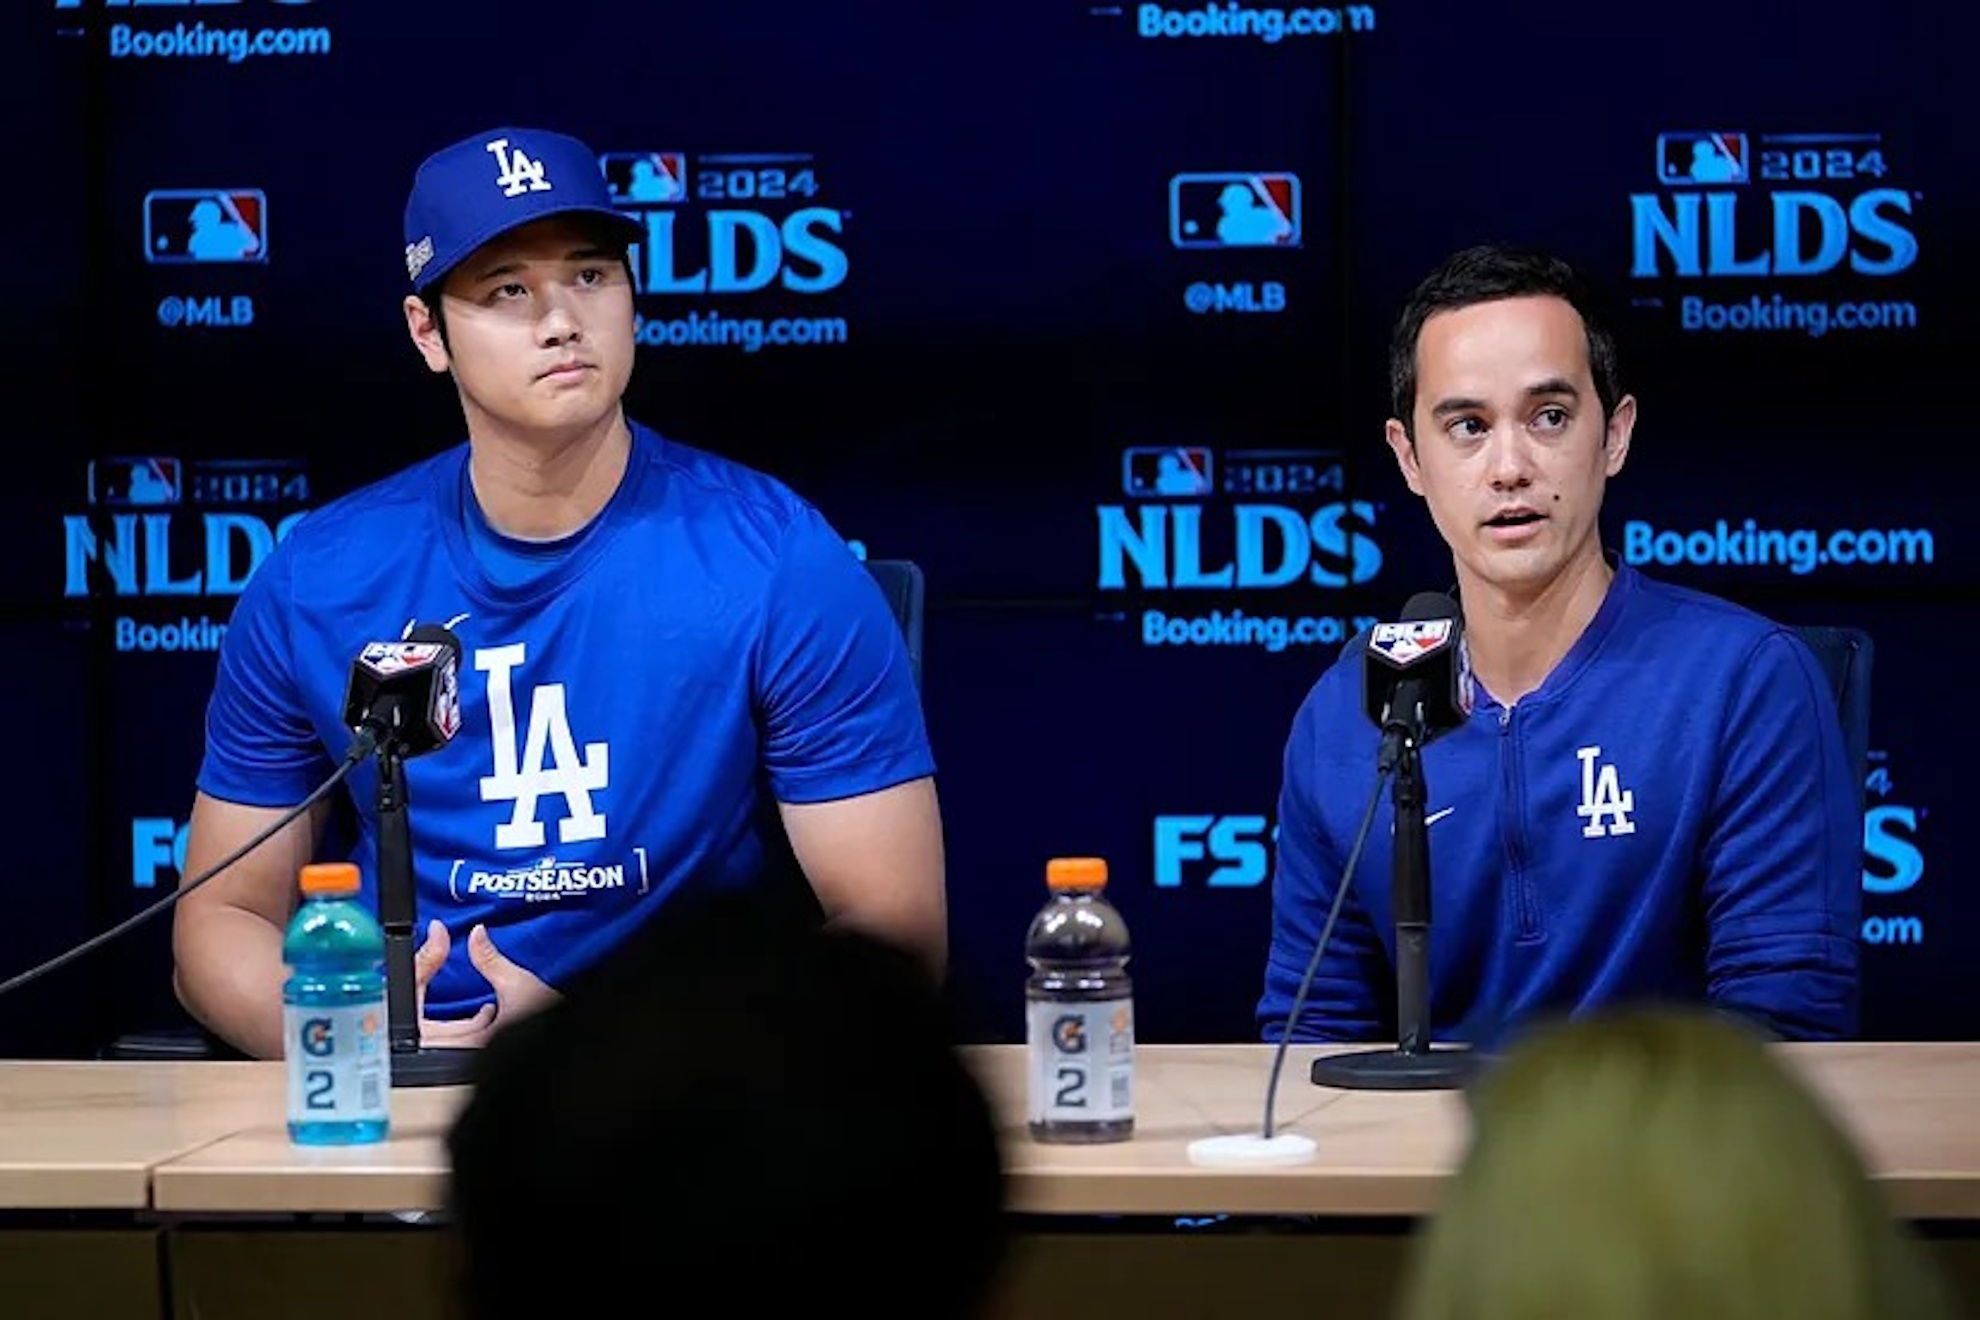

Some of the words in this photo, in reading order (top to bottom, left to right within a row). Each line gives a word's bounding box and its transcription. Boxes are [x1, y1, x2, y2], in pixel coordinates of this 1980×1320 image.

[110, 22, 331, 63] Booking.com
[486, 138, 552, 198] LA
[698, 169, 820, 199] 2024
[1761, 150, 1888, 180] 2024
[1629, 188, 1919, 278] NLDS
[157, 296, 256, 327] @MLB
[1184, 281, 1288, 314] @MLB
[1681, 294, 1918, 338] Booking.com
[1223, 464, 1344, 494] 2024
[63, 511, 310, 597] NLD
[1096, 500, 1384, 590] NLDS
[1623, 519, 1934, 575] Booking.com
[475, 643, 609, 849] LA
[1577, 746, 1635, 838] LA
[1154, 814, 1281, 888] FS
[468, 865, 625, 893] POSTSEASON
[307, 1070, 335, 1109] 2
[1055, 1068, 1086, 1107] 2
